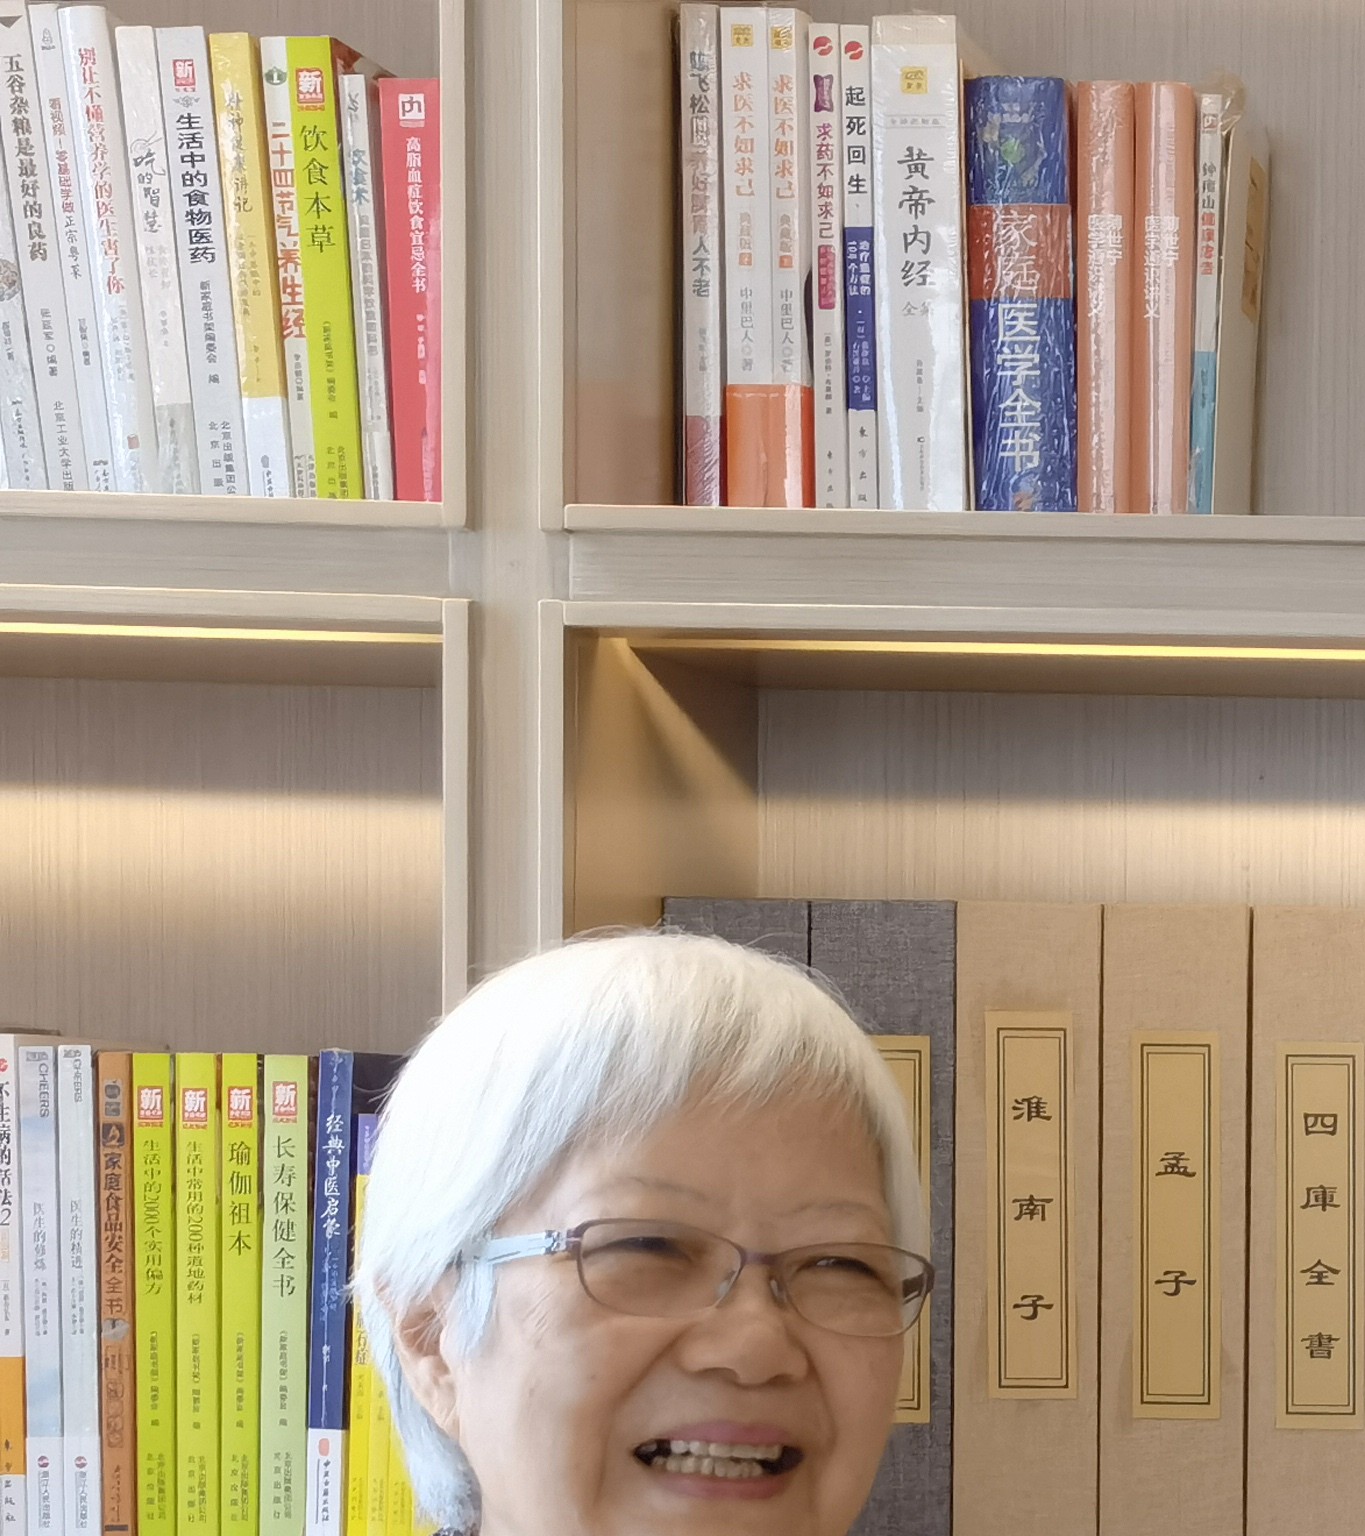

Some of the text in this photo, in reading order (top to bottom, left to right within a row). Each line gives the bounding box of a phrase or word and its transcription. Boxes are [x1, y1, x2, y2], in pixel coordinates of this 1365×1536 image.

[3, 53, 48, 262] 五谷杂粮是最好的良药
[78, 47, 125, 294] 别让不懂营养学的医生害了你
[132, 149, 166, 233] 吃的智慧
[176, 112, 216, 264] 生活中的食物医药
[301, 125, 336, 254] 饮食本草
[732, 72, 755, 197] 求医不如求己
[773, 74, 796, 199] 求医不如求己
[816, 122, 835, 239] 求药不如求己
[845, 85, 868, 195] 起死回生
[271, 121, 307, 340] 二十四节气养生经
[405, 135, 428, 293] 高脂血症饮食宜忌全书
[896, 146, 937, 287] 黄帝内经
[995, 210, 1042, 474] 家庭医学全书
[38, 1062, 50, 1119] CHEERS
[143, 1139, 163, 1296] 生活中的2000个实用偏方
[228, 1140, 253, 1257] 瑜伽祖本
[271, 1134, 297, 1298] 长寿保健全书
[321, 1113, 346, 1239] 经典中医启蒙
[1011, 1094, 1055, 1322] 淮南子
[1154, 1151, 1198, 1298] 孟子
[1299, 1111, 1342, 1361] 四庫全書
